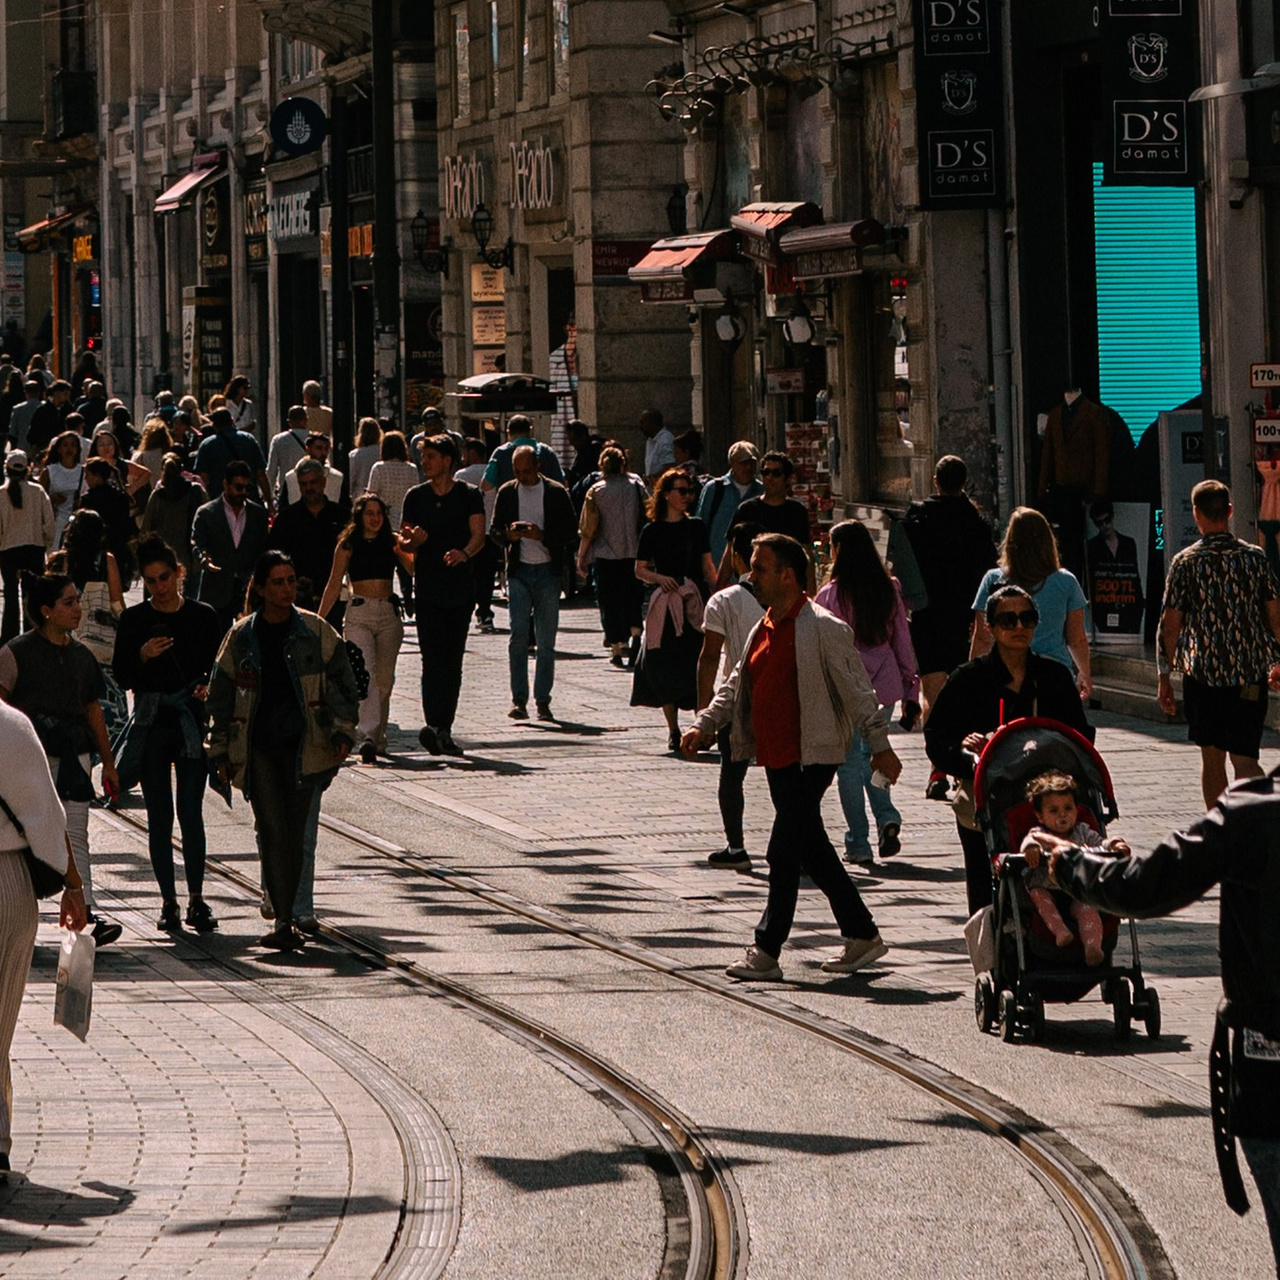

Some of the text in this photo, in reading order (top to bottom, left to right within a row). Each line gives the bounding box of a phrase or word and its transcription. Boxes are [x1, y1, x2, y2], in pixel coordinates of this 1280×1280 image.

[929, 0, 982, 28] D'S
[930, 29, 984, 44] damat
[1121, 111, 1179, 143] D'S
[935, 140, 988, 168] D'S
[1121, 145, 1181, 160] damat
[509, 136, 554, 210] DeFacto
[935, 171, 989, 185] damat
[444, 149, 484, 220] DeFacto
[595, 244, 618, 255] EMİR
[1095, 579, 1136, 592] 500 TL
